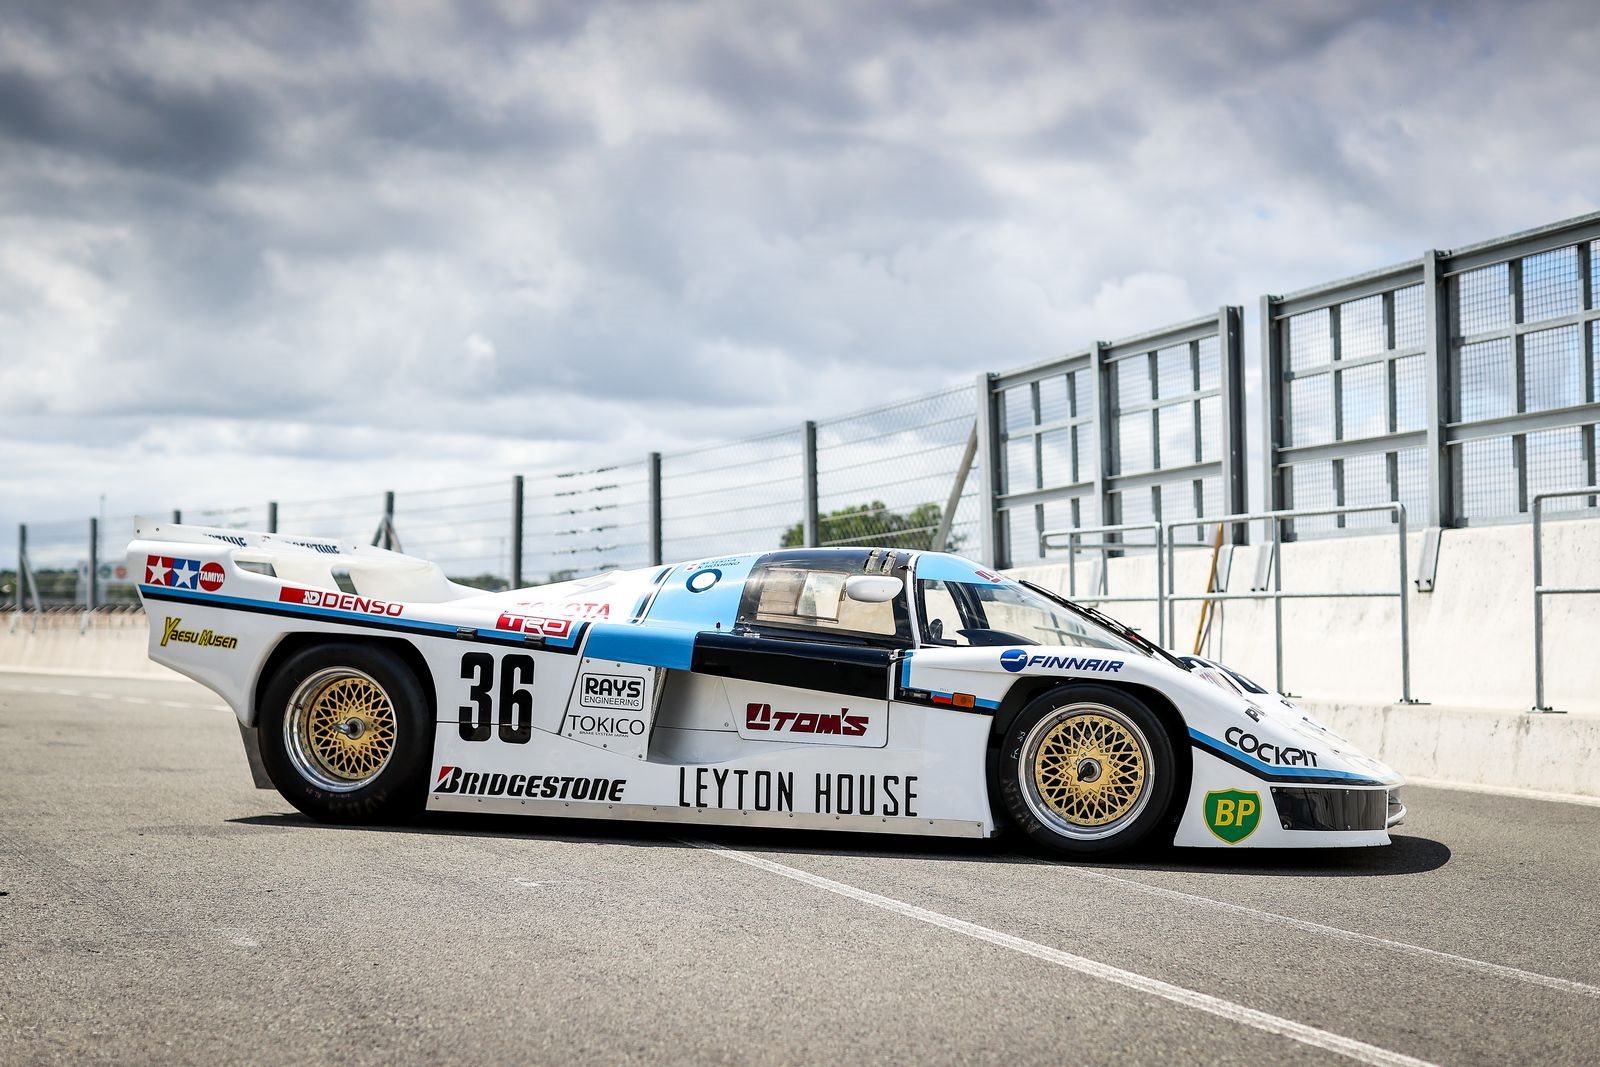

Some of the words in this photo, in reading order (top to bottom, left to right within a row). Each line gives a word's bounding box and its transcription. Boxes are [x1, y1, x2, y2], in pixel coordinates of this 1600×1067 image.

[199, 570, 225, 583] TAMIYA
[322, 592, 404, 617] DENSO
[1027, 655, 1125, 673] FINNAIR
[458, 652, 535, 745] 36
[585, 677, 642, 698] RAYS
[584, 695, 640, 707] ENGINEERING
[568, 714, 646, 736] TOKICO
[773, 707, 870, 737] TOM'S
[1224, 726, 1318, 768] COCKPIT
[433, 765, 627, 802] BRIDGESTONE
[679, 767, 794, 812] LEYTON
[815, 772, 919, 817] HOUSE
[1214, 799, 1256, 826] BP
